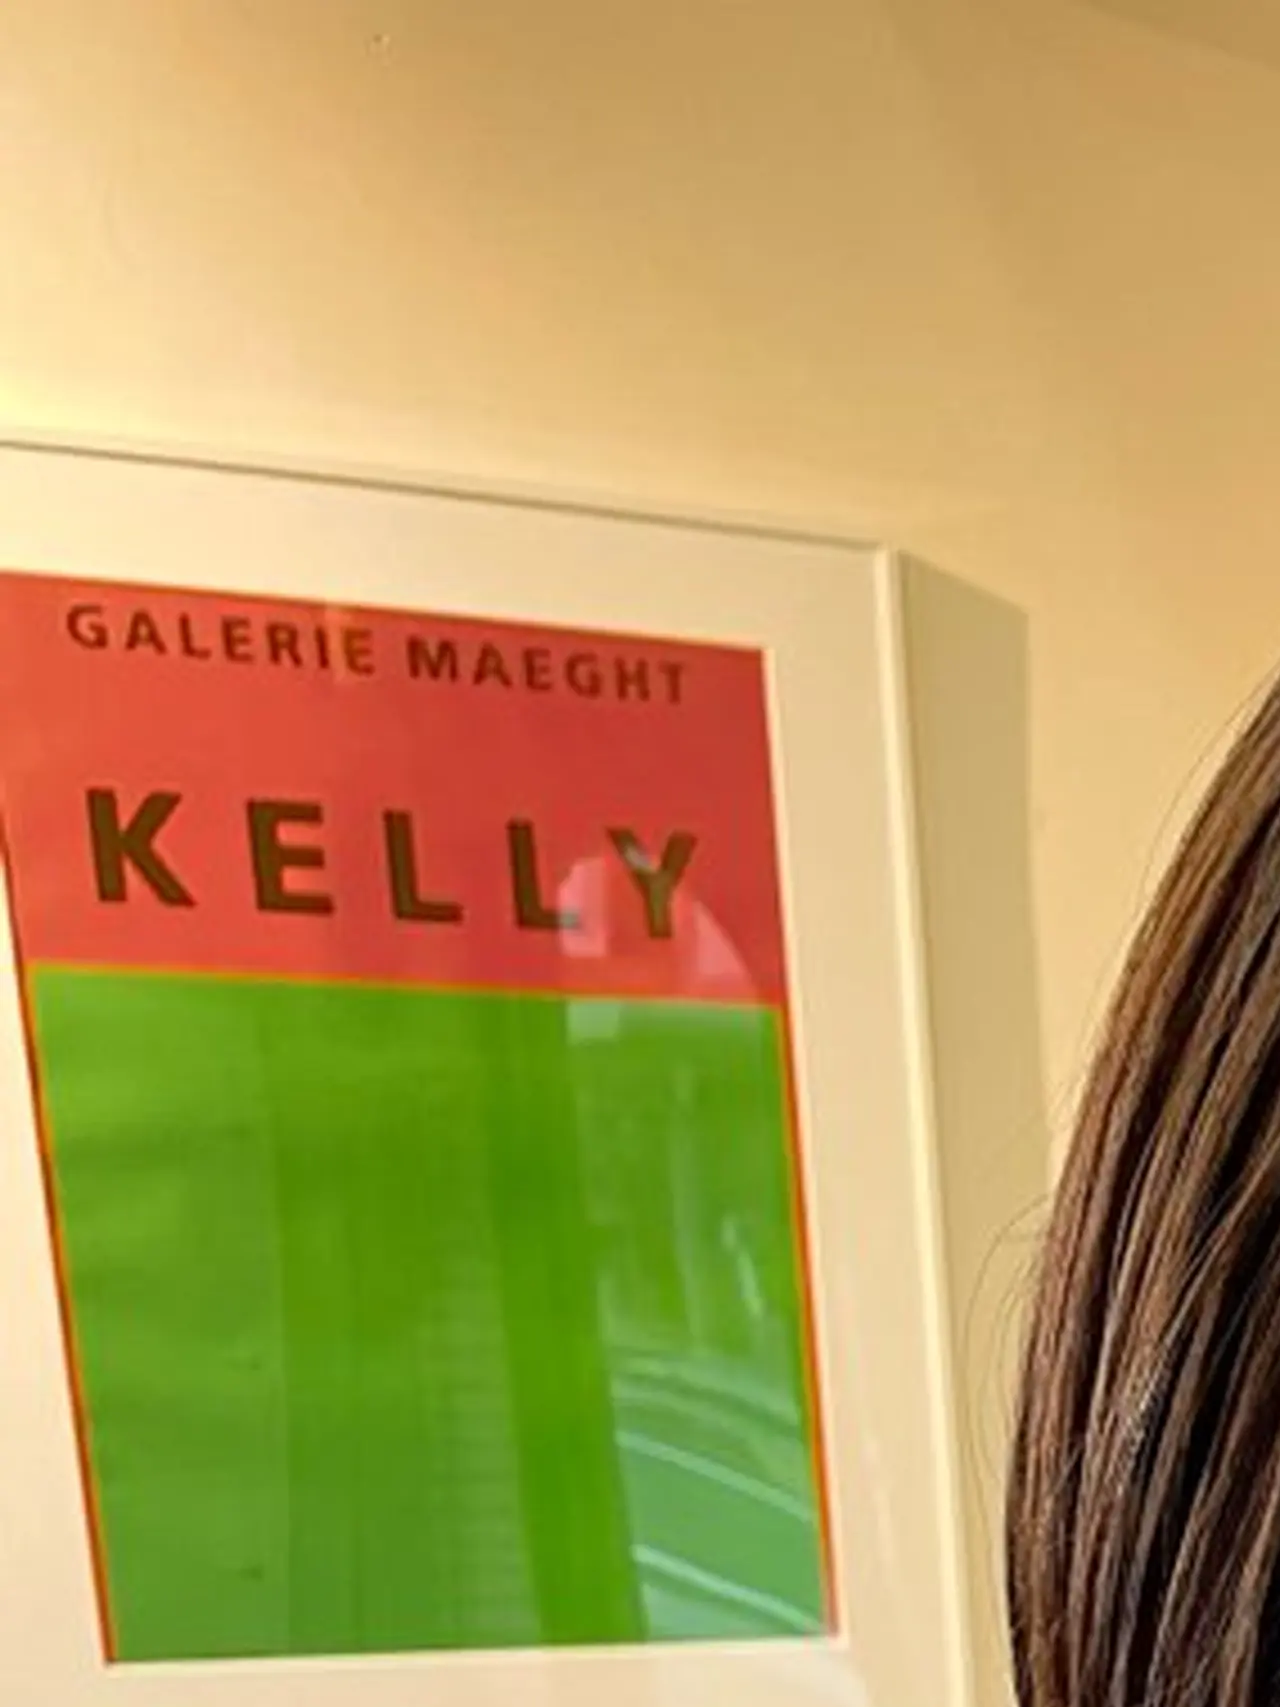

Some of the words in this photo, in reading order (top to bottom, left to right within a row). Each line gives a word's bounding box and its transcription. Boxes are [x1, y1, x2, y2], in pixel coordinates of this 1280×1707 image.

[66, 604, 377, 676] GALERIE
[407, 637, 687, 705] MAEGHT
[86, 787, 698, 939] KELLY
